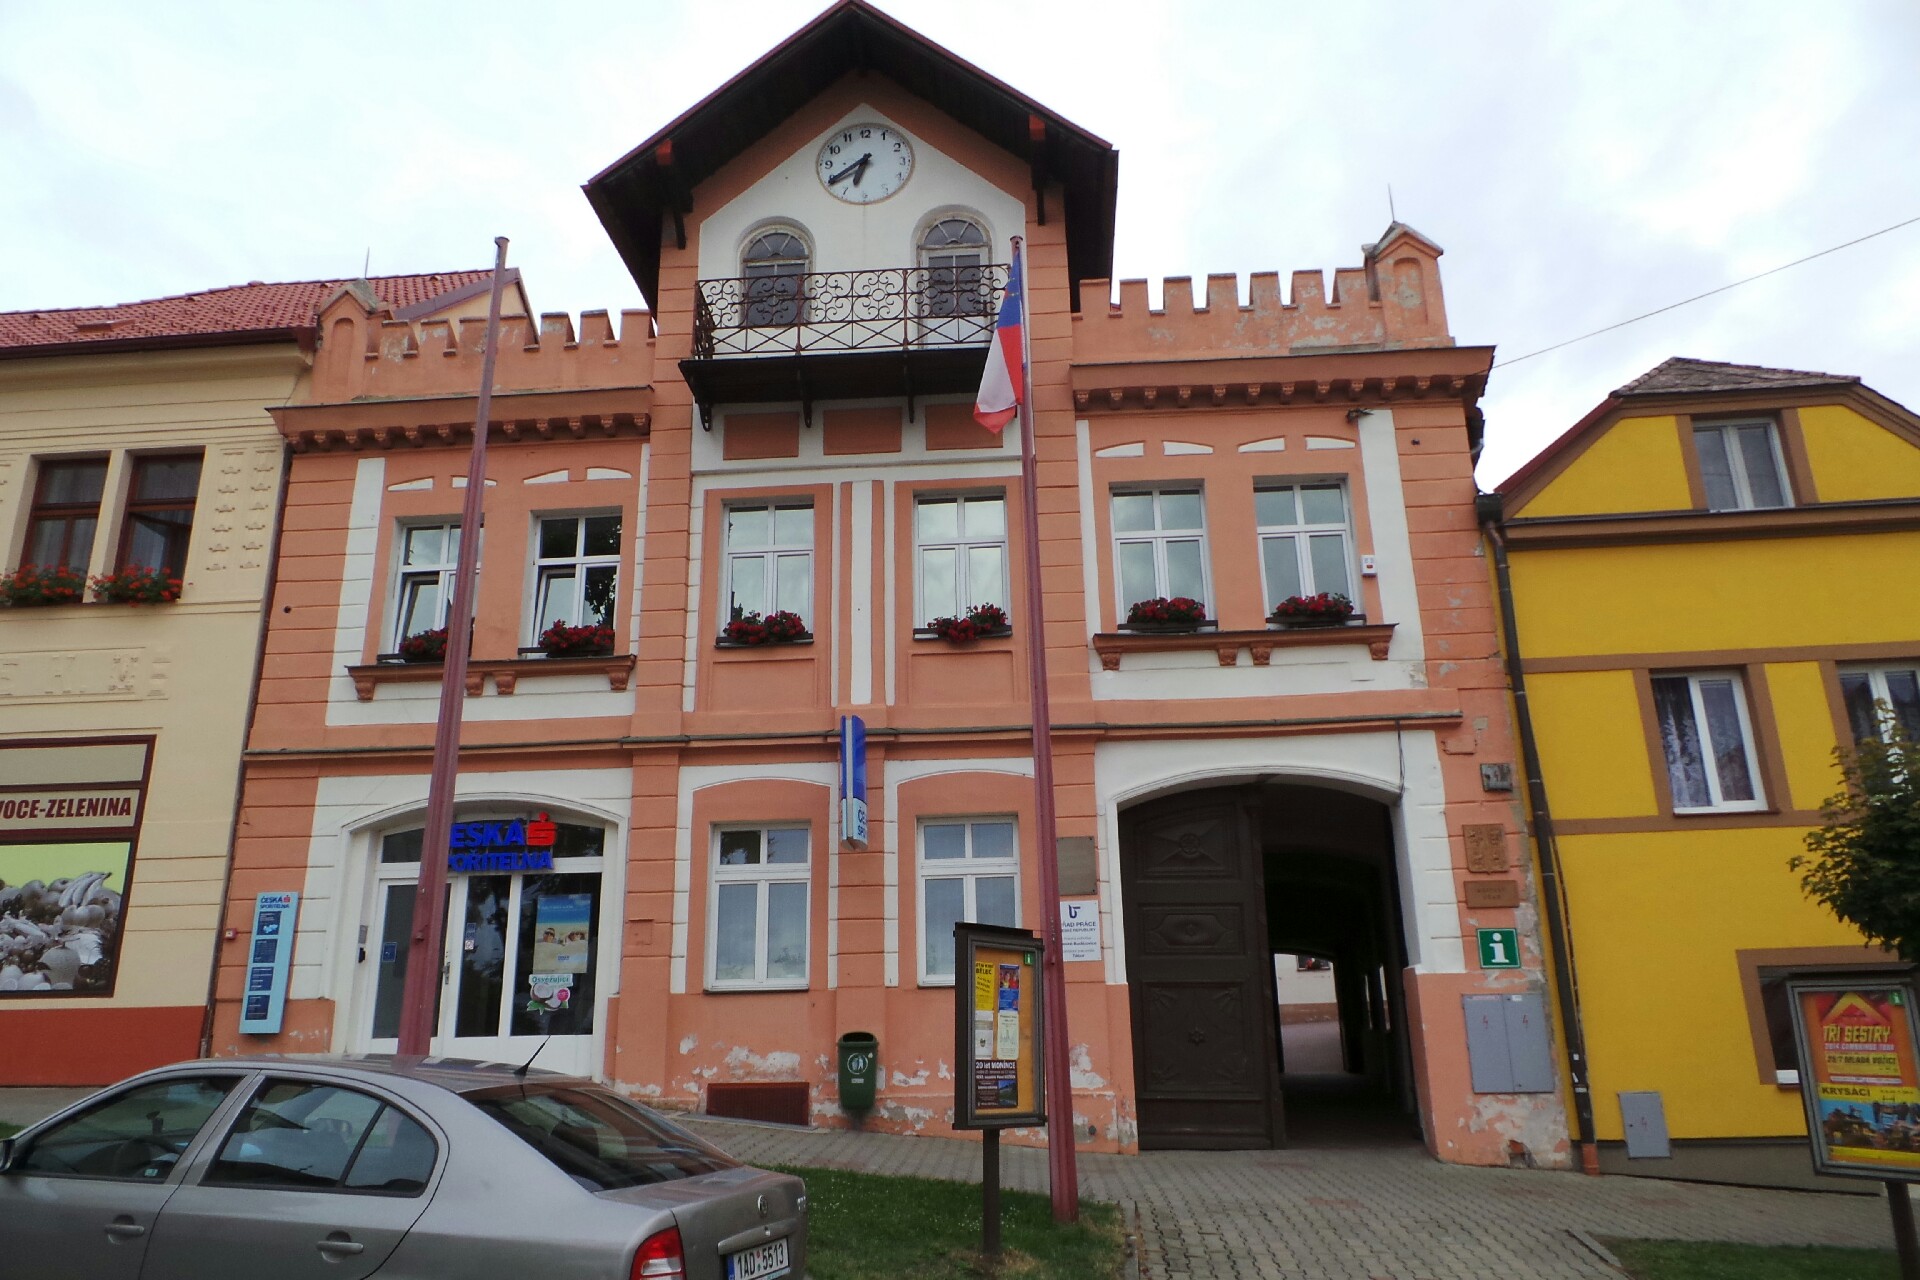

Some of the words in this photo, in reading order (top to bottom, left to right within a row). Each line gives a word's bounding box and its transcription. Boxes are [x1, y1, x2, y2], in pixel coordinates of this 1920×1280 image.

[843, 132, 852, 142] 11
[860, 130, 871, 138] 12
[881, 131, 886, 140] 1
[829, 145, 840, 154] 10
[893, 143, 901, 152] 2
[825, 160, 833, 169] 9
[899, 157, 906, 165] 3
[450, 818, 525, 848] ESKÁ
[448, 850, 554, 873] OŘITELNA
[260, 896, 283, 904] ČESKÁ
[1845, 1026, 1891, 1043] SESTRY
[738, 1252, 756, 1279] 1AD
[762, 1242, 784, 1270] 5513
